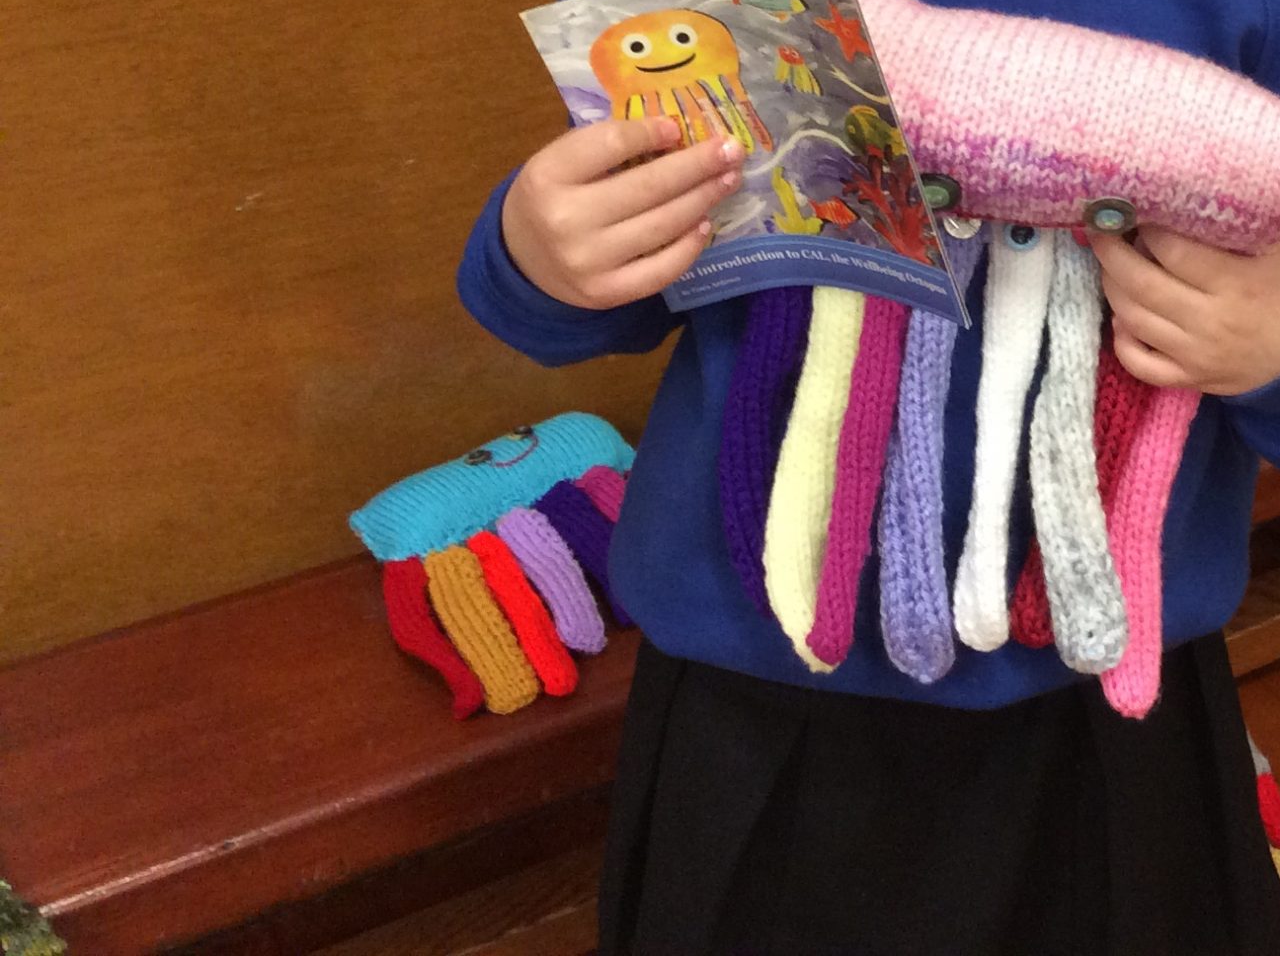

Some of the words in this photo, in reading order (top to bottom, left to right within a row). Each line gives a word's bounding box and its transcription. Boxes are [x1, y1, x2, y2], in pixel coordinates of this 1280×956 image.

[697, 249, 785, 276] Introduction
[786, 249, 801, 260] to
[831, 252, 850, 266] the
